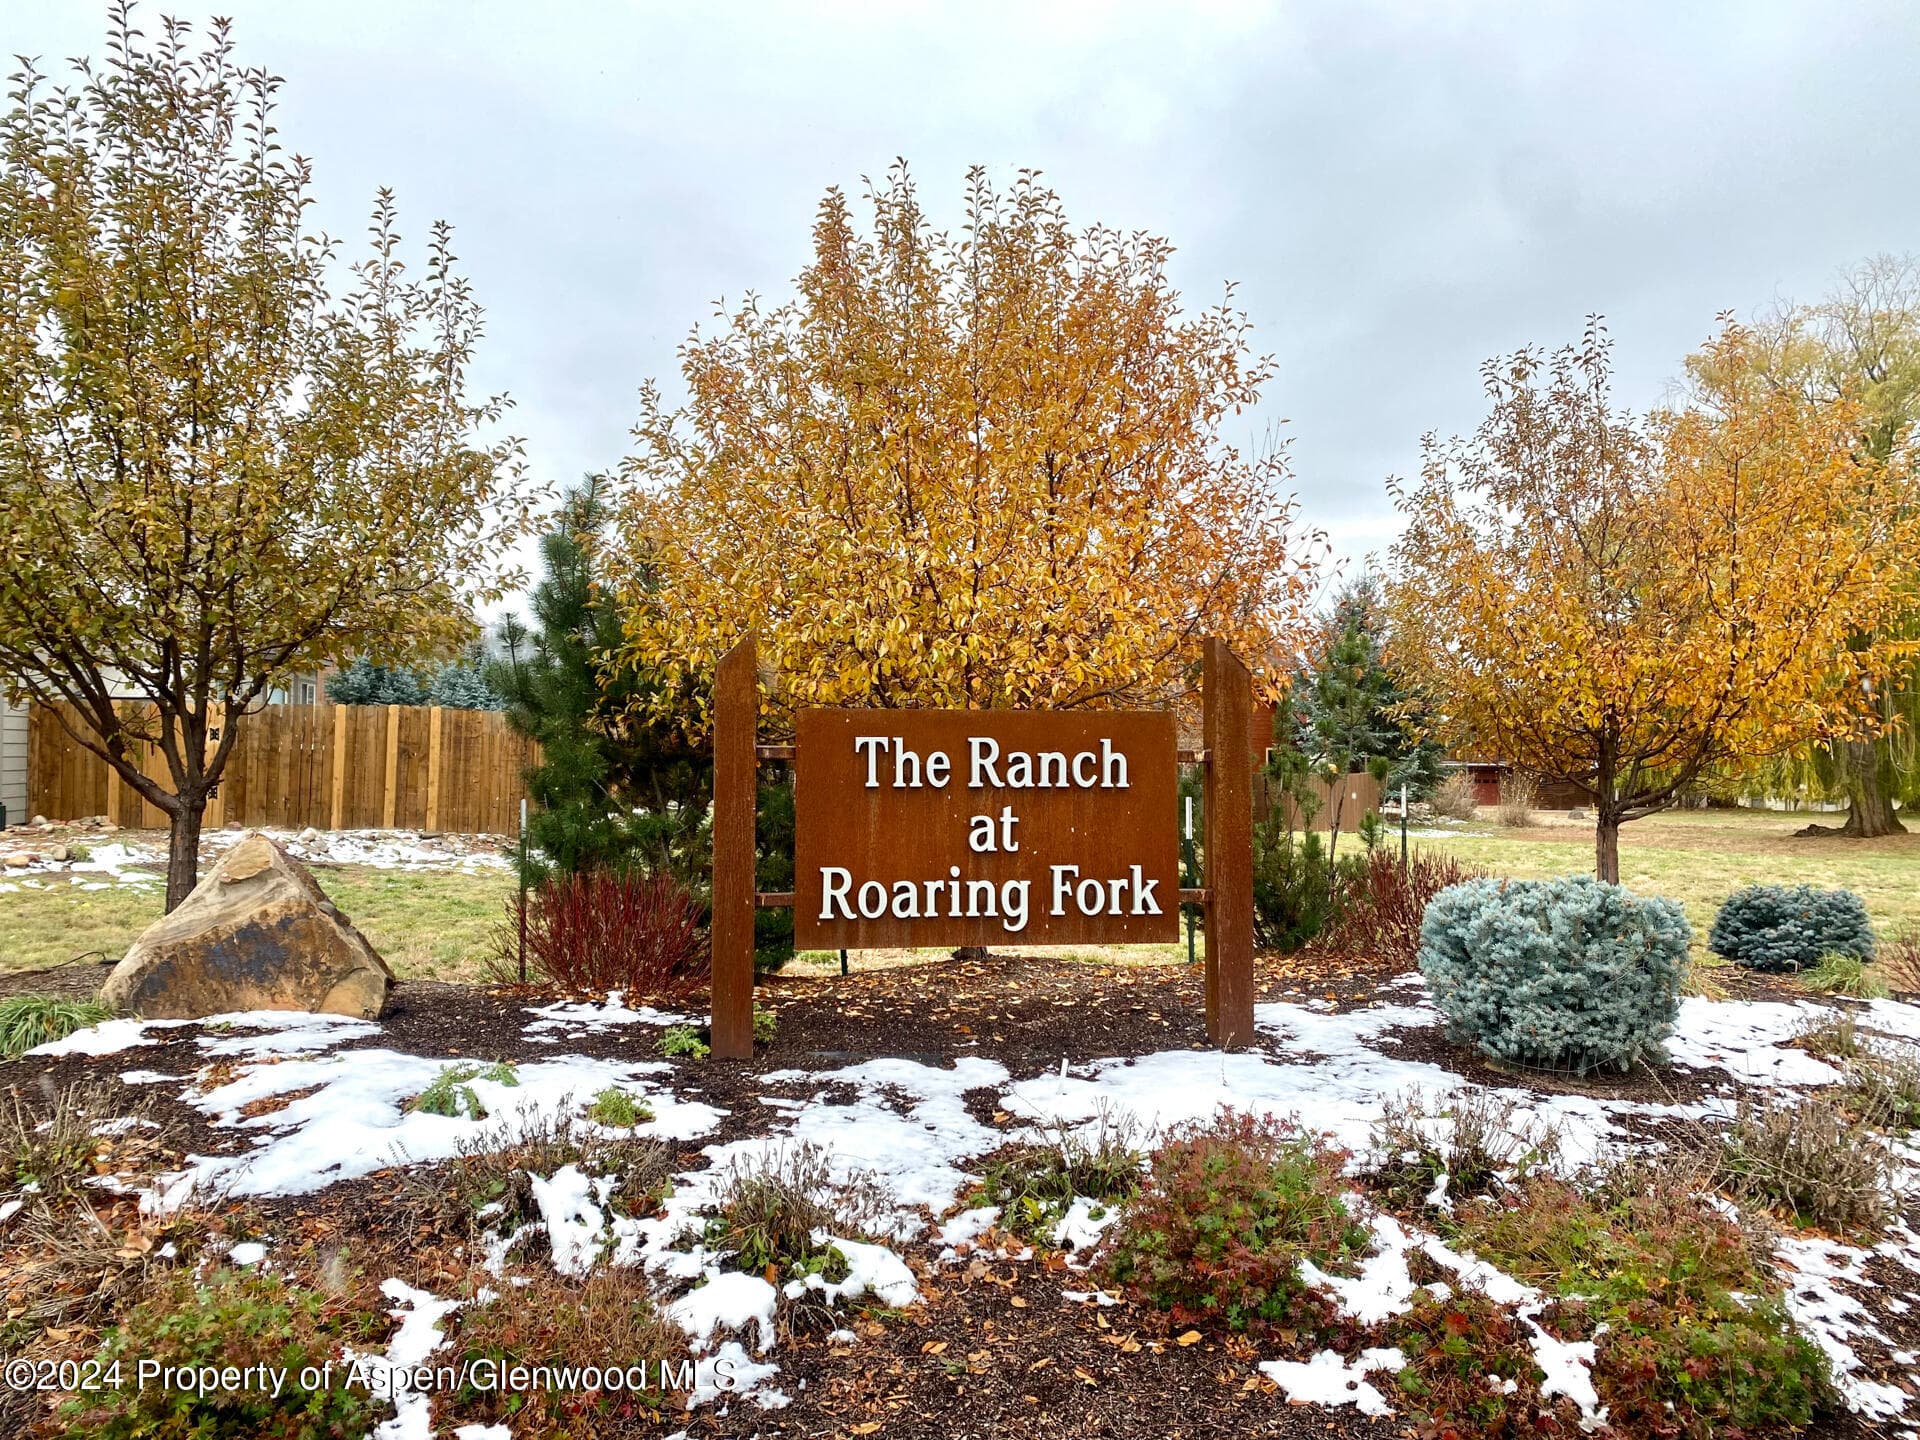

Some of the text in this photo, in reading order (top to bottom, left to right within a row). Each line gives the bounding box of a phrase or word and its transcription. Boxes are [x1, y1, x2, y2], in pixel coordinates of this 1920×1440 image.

[855, 736, 1130, 788] The Ranch
[968, 805, 1019, 852] at
[818, 864, 1163, 932] Roaring Fork
